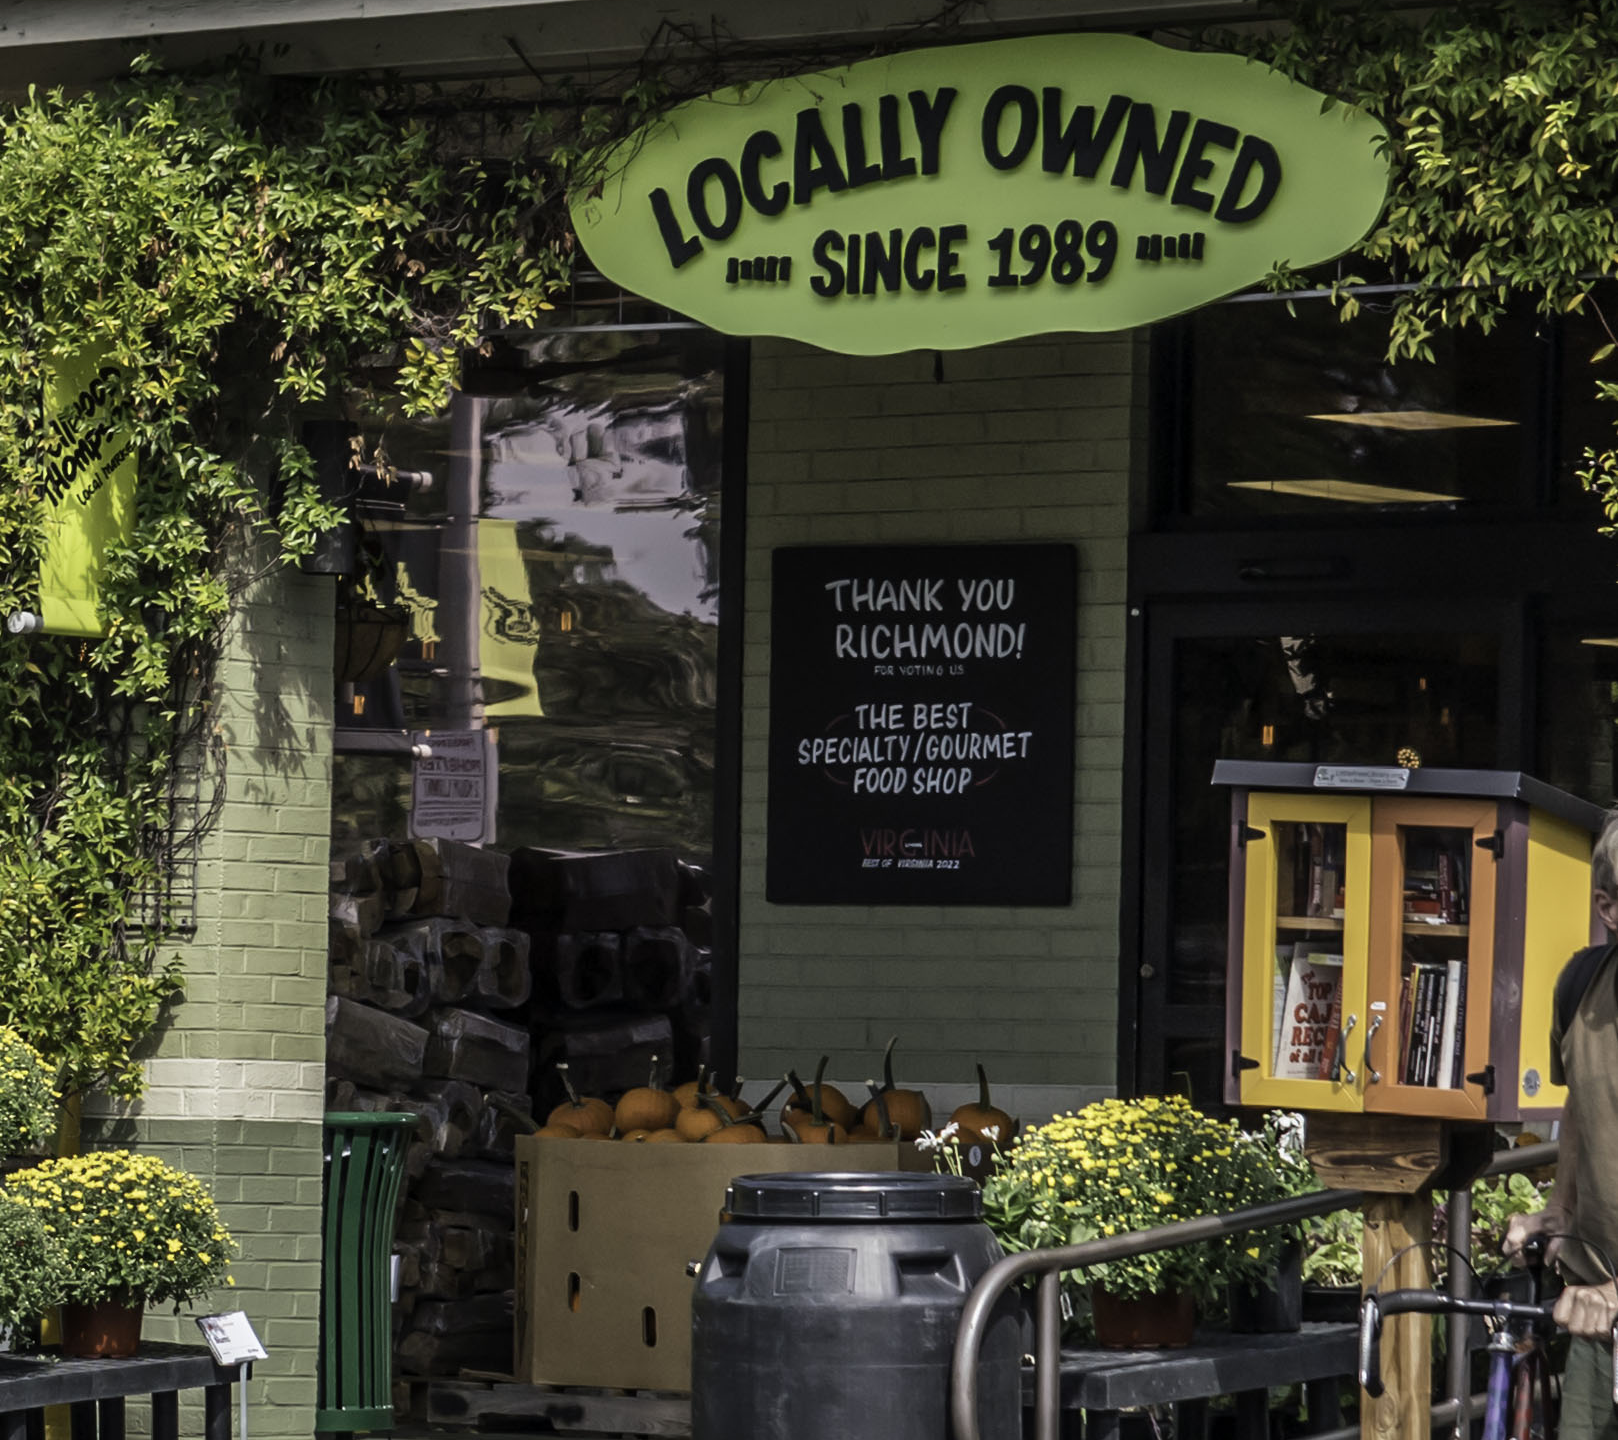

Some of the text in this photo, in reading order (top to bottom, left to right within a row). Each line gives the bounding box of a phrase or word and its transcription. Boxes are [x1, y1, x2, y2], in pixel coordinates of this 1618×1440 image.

[647, 84, 1283, 269] LOCALLY OWNED
[809, 219, 1120, 298] SINCE 1989
[825, 577, 1015, 613] THANK YOU
[835, 622, 1027, 660] RICHMOND!
[874, 664, 965, 677] FOR VOTING US
[855, 702, 974, 730] THE BEST
[853, 766, 973, 795] FOOD SHOP
[860, 827, 976, 858] VIRGINIA
[936, 859, 961, 870] 2022
[1308, 982, 1333, 1001] TOP
